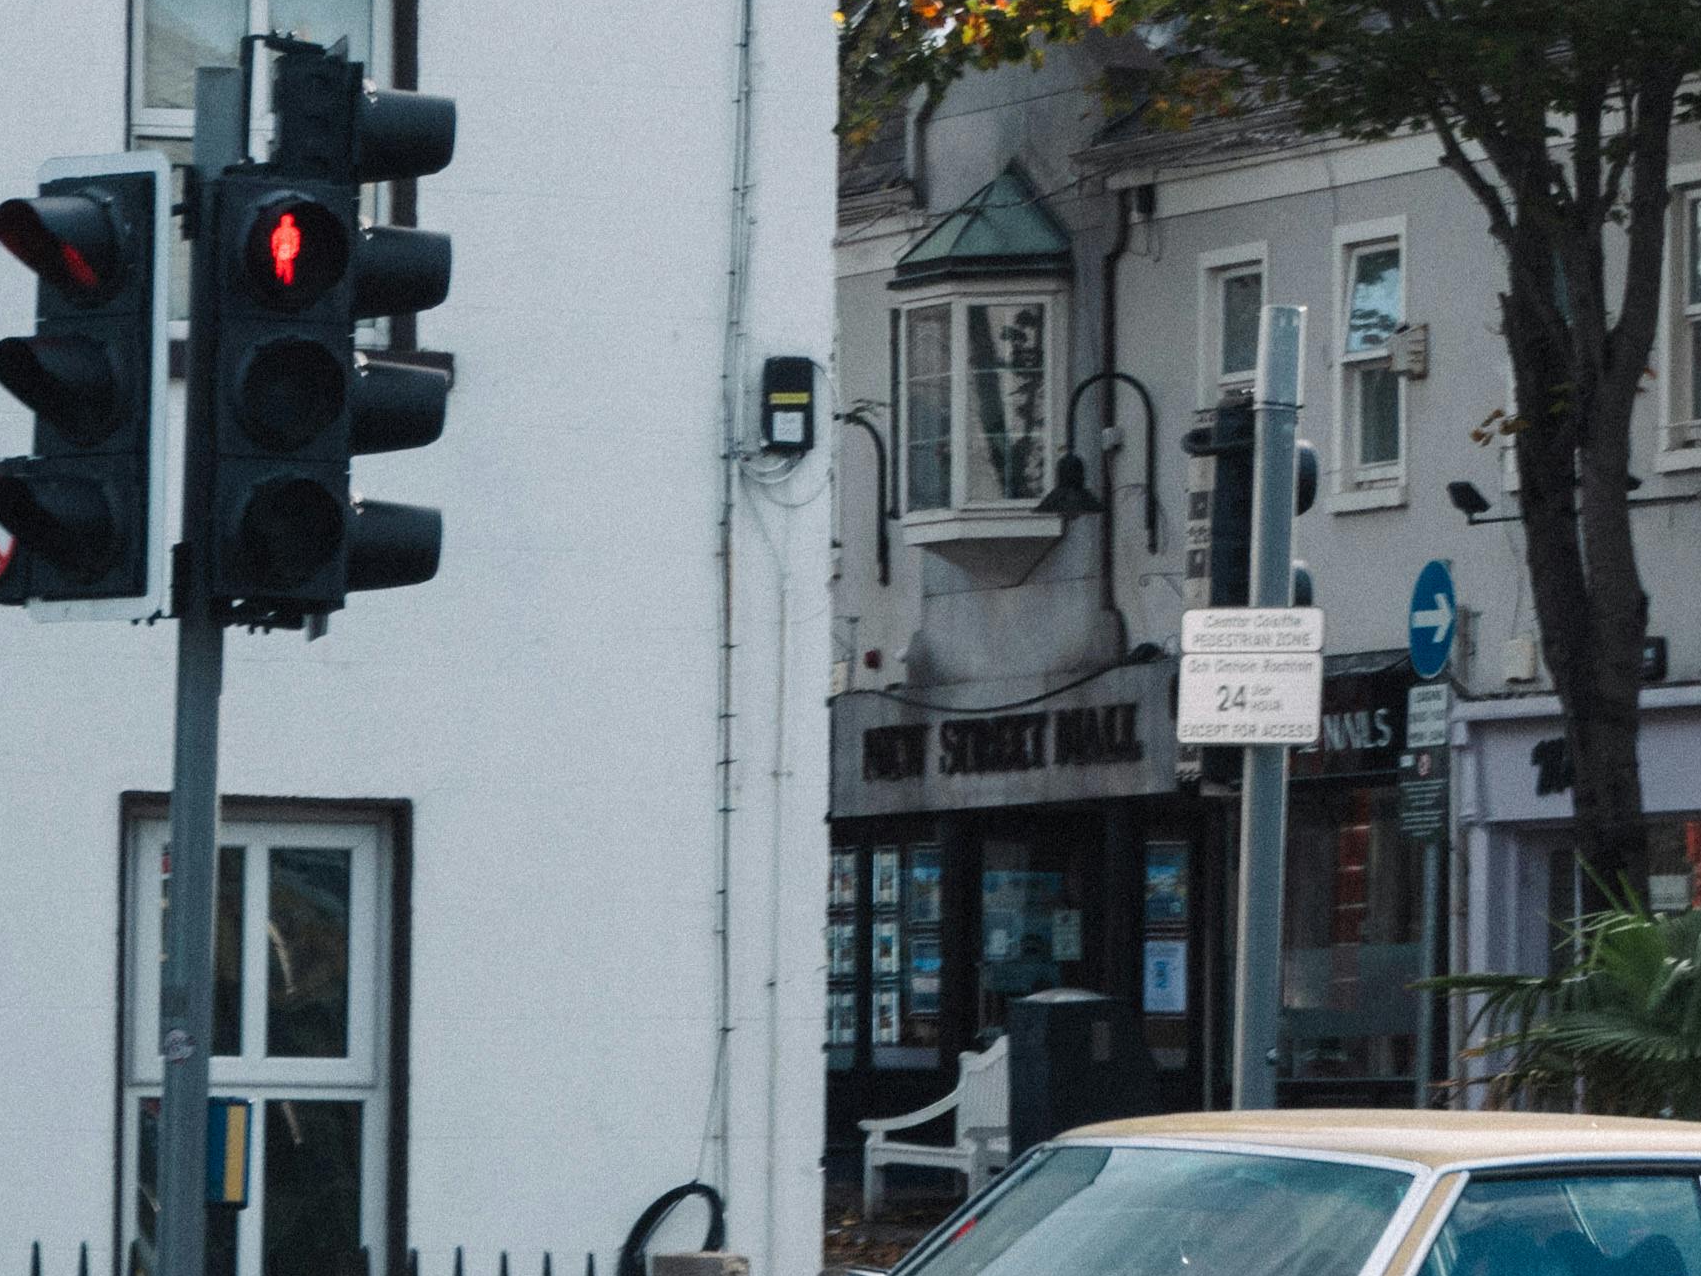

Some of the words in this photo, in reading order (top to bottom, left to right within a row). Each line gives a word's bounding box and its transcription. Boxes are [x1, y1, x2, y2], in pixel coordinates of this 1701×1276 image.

[1193, 633, 1271, 648] PEDESTRIAN
[1275, 632, 1311, 647] ZONE
[1217, 684, 1247, 712] 24
[939, 711, 1048, 775] STREET
[1181, 724, 1229, 738] EXCEPT
[1232, 724, 1257, 738] FOR
[1262, 724, 1313, 738] ACCESS
[1323, 707, 1392, 752] NAILS
